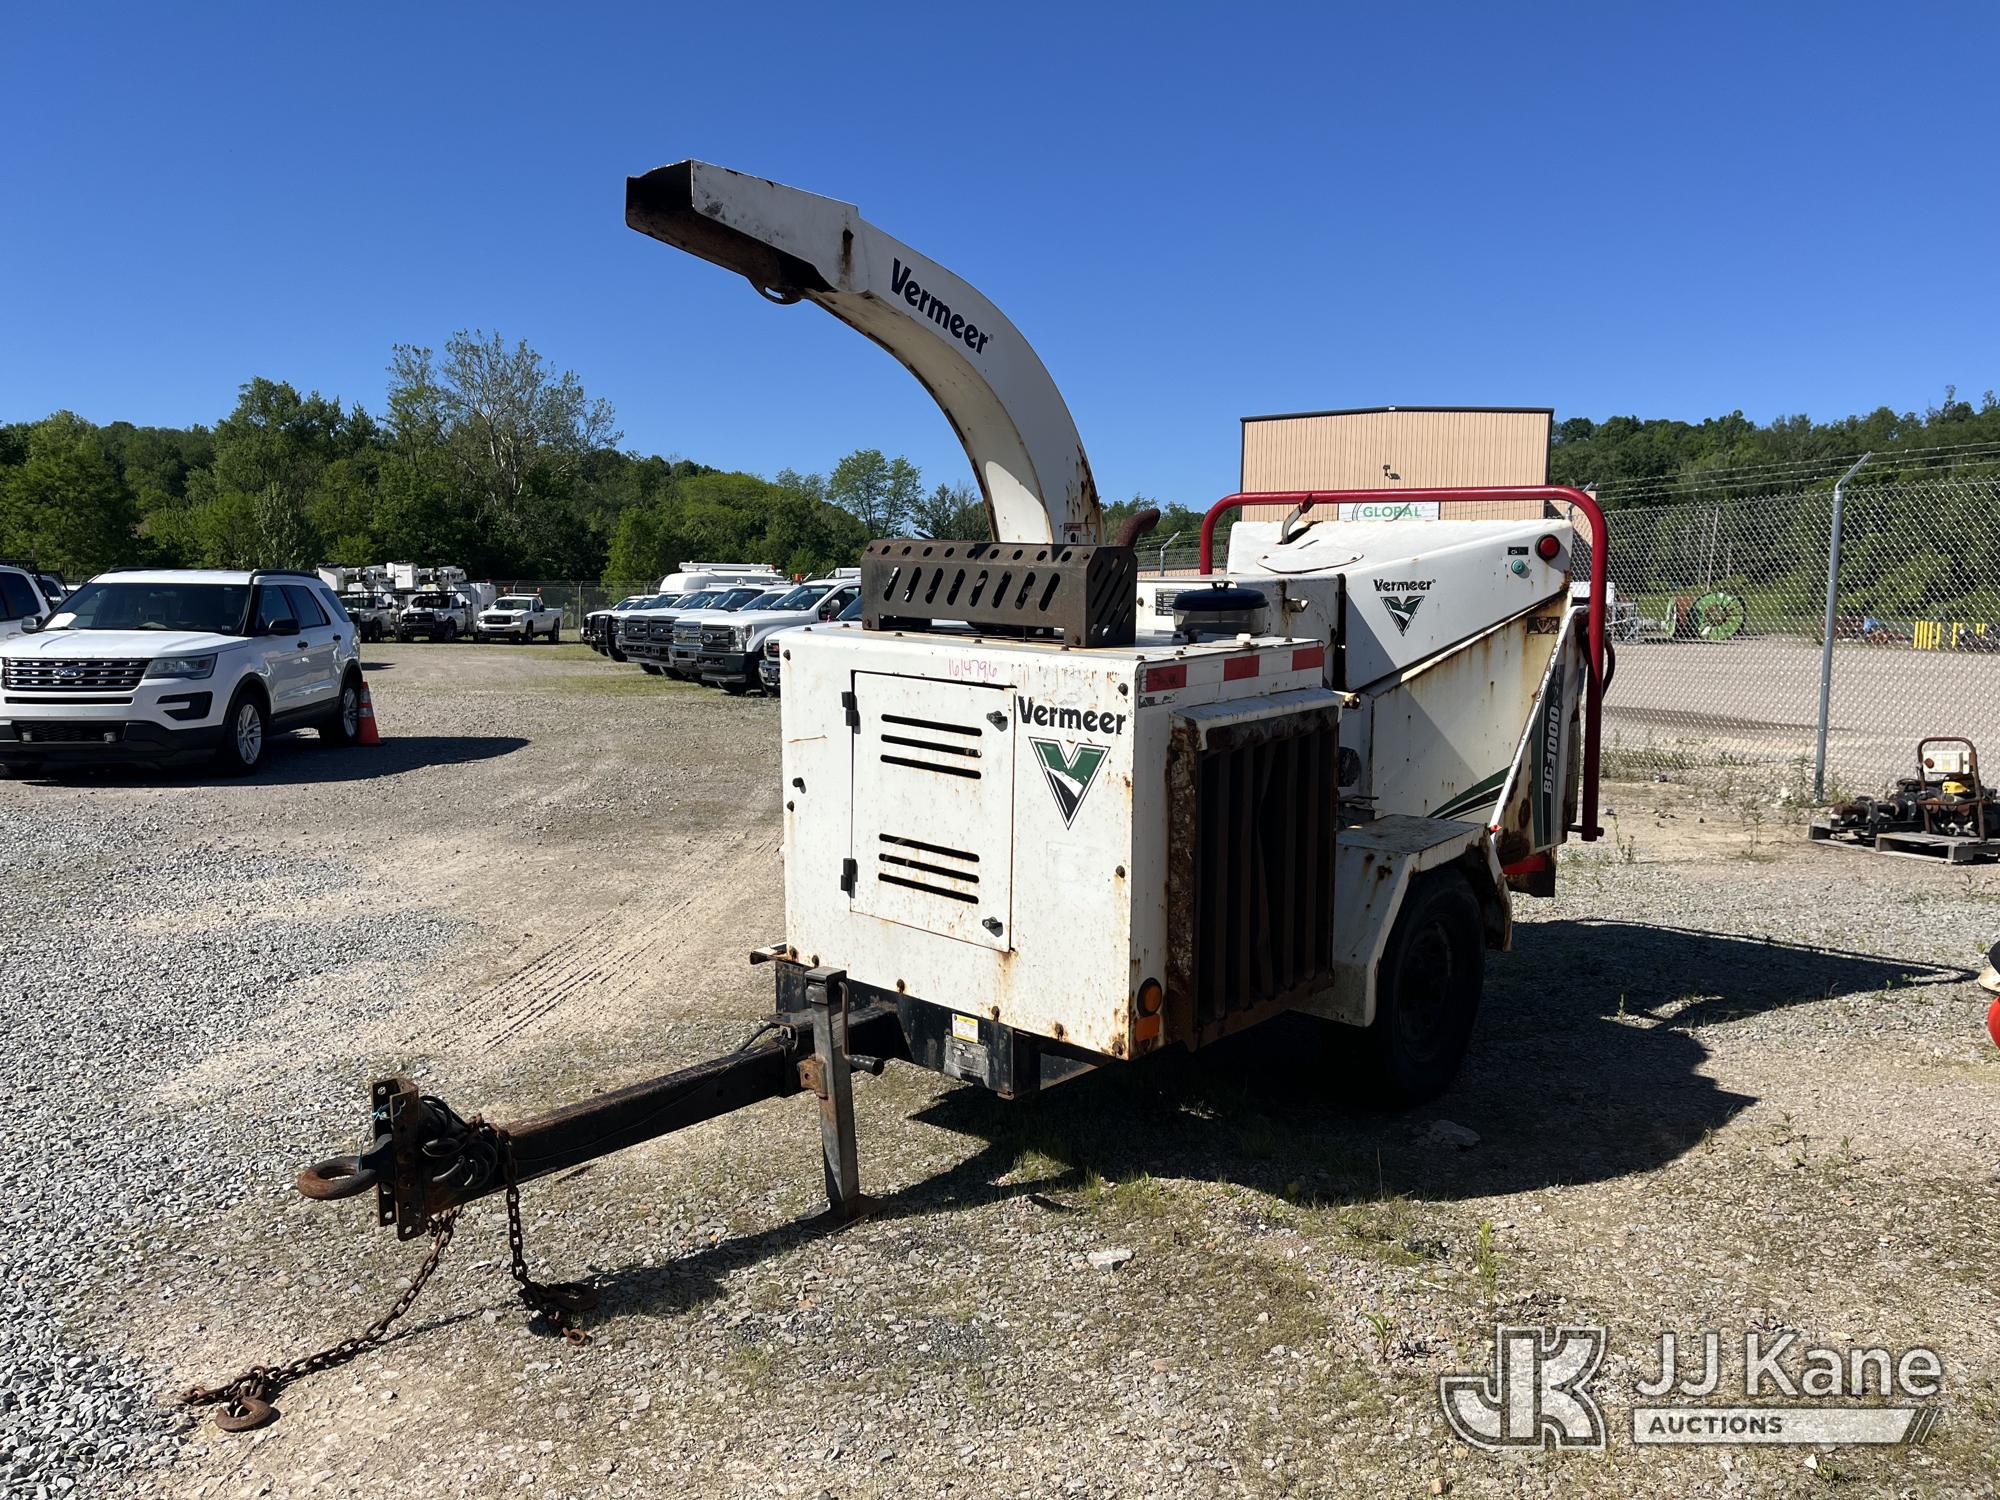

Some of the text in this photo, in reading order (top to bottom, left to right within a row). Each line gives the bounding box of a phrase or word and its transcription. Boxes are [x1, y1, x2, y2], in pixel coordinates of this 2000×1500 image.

[891, 257, 989, 355] Vermeer
[1373, 578, 1432, 592] Vermeer
[1018, 695, 1126, 735] Vermeer
